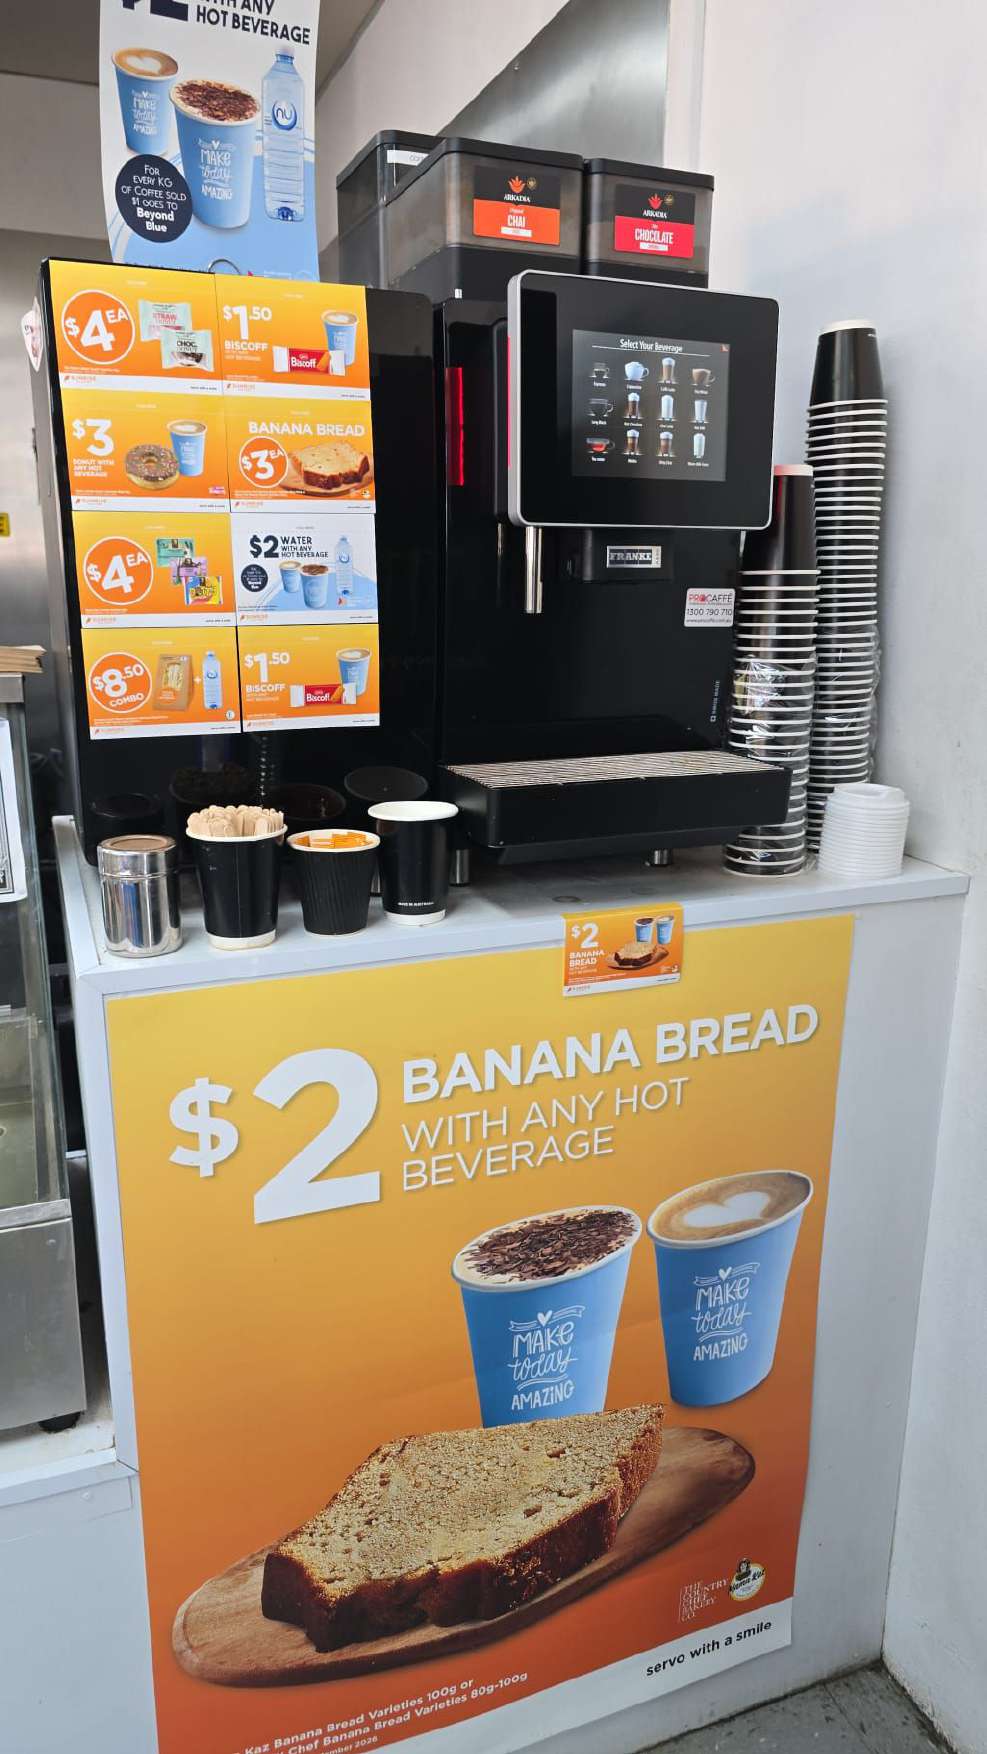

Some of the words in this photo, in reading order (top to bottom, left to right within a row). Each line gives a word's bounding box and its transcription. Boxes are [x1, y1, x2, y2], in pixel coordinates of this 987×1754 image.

[196, 4, 229, 27] HOT
[231, 13, 311, 46] BEVERAGE
[144, 164, 160, 176] FOR
[133, 175, 155, 185] EVERY
[158, 177, 173, 188] KG
[121, 185, 132, 194] OF
[134, 186, 163, 199] COFFEE
[166, 191, 187, 201] SOLD
[503, 193, 531, 203] ARKADIA
[131, 196, 140, 206] $1
[142, 200, 164, 209] GOES
[166, 201, 178, 211] TO
[136, 207, 175, 222] Beyond
[507, 214, 526, 228] CHAI
[642, 209, 668, 219] ARKADIA
[145, 220, 168, 232] Blue
[634, 228, 674, 244] CHOCOLATE
[223, 304, 273, 340] $1.50
[224, 340, 269, 352] BISCOFF
[620, 338, 639, 349] Select
[639, 340, 654, 350] Your
[655, 342, 683, 354] Beverage
[291, 356, 316, 369] Biscoff
[248, 421, 312, 435] BANANA
[317, 423, 365, 437] BREAD
[72, 418, 115, 457] $3
[249, 534, 279, 558] $2
[280, 536, 313, 545] WATER
[610, 552, 652, 561] FRANKE
[687, 608, 704, 616] 1300
[706, 608, 719, 616] 790
[720, 608, 733, 616] 710
[244, 652, 290, 683] $1.50
[93, 663, 145, 698] $8.50
[245, 683, 286, 693] BISCOFF
[109, 692, 144, 707] COMBO
[571, 922, 599, 949] $2
[569, 949, 605, 960] BANANA
[569, 957, 597, 968] BREAD
[403, 1028, 641, 1104] BANANA
[656, 1004, 818, 1064] BREAD
[401, 1106, 507, 1152] WITH
[520, 1090, 604, 1133] ANY
[615, 1077, 689, 1116] HOT
[168, 1047, 381, 1224] $2
[403, 1125, 615, 1192] BEVERAGE
[694, 1276, 750, 1311] MAKE
[691, 1302, 753, 1333] today
[512, 1320, 575, 1357] MAKE
[693, 1334, 749, 1362] AMAZING
[508, 1348, 579, 1382] today
[511, 1380, 575, 1411] AMAZING
[646, 1653, 685, 1676] servo
[690, 1640, 720, 1659] with
[724, 1637, 733, 1647] a
[736, 1621, 772, 1642] smile
[245, 1744, 270, 1754] Kaz
[274, 1727, 323, 1749] Banana
[327, 1713, 365, 1732] Bread
[368, 1697, 423, 1721] Varieties
[427, 1684, 457, 1702] 100g
[460, 1679, 474, 1690] or
[288, 1739, 319, 1754] Chef
[323, 1726, 370, 1746] Banana
[374, 1710, 411, 1731] Bread
[415, 1693, 468, 1718] Varieties
[471, 1672, 528, 1699] 80g-100g
[355, 1735, 378, 1748] 2026
